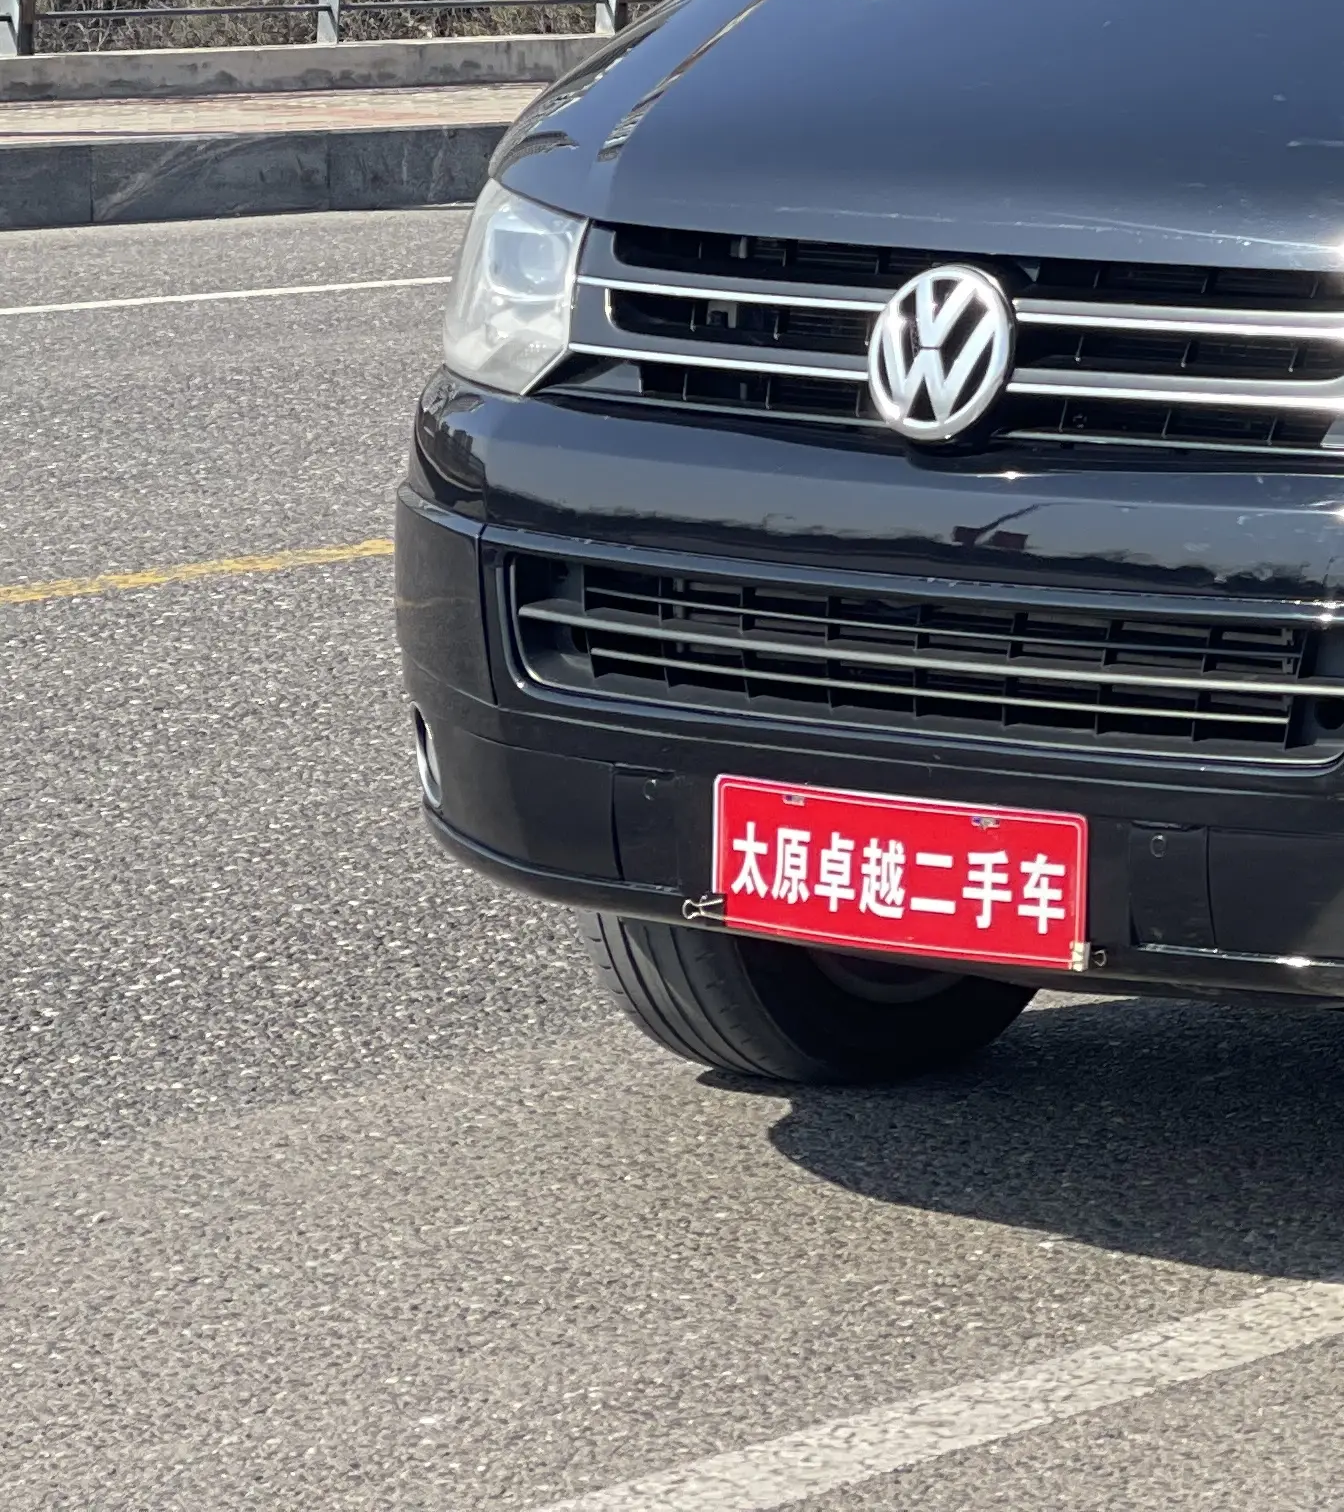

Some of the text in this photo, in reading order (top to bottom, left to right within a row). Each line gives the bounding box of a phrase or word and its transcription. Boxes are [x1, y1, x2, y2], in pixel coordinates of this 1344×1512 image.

[868, 264, 1014, 442] VW
[730, 820, 1067, 935] 太原卓越二手车
